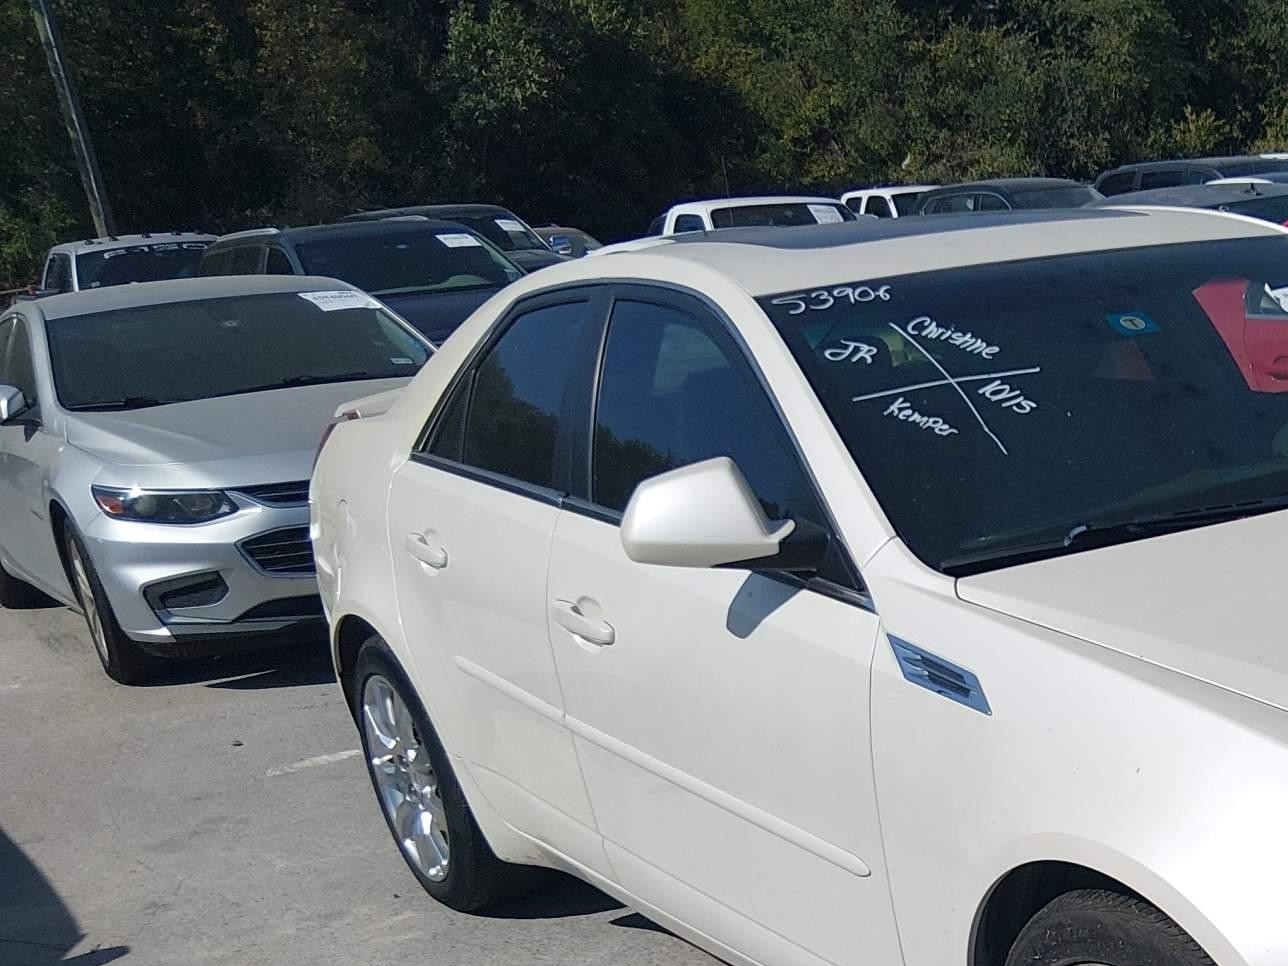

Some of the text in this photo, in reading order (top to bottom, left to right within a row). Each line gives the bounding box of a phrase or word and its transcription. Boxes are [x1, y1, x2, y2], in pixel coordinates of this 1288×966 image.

[771, 285, 892, 315] 53906
[906, 315, 1001, 360] Christine
[882, 397, 959, 438] Kemper
